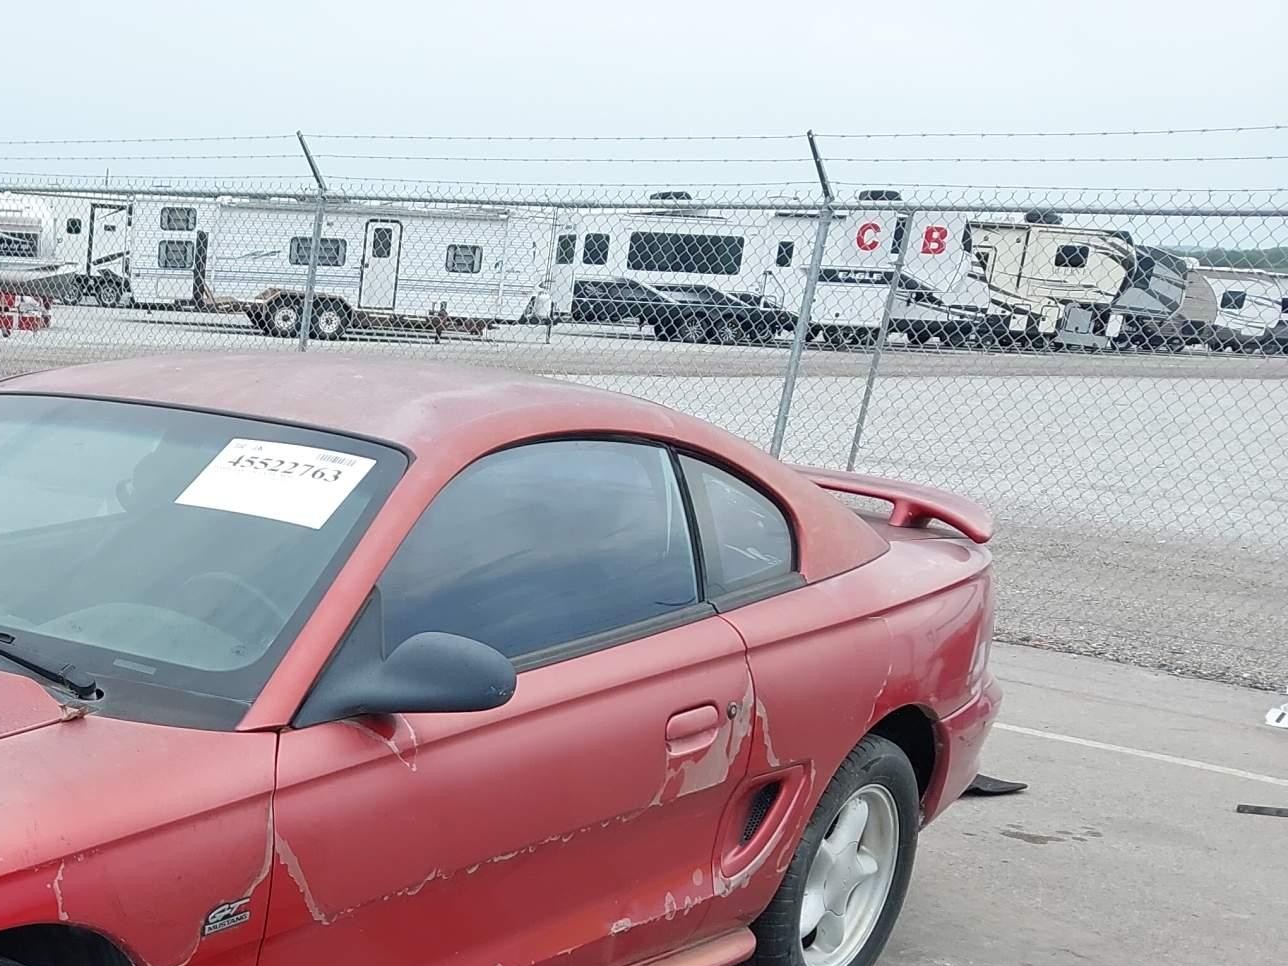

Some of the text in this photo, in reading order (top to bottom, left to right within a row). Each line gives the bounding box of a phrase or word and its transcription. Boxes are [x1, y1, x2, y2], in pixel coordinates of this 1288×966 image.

[856, 222, 882, 251] C
[920, 225, 948, 255] B
[228, 454, 343, 483] 45522763
[206, 913, 249, 933] MUSTANG
[208, 897, 251, 923] GT
